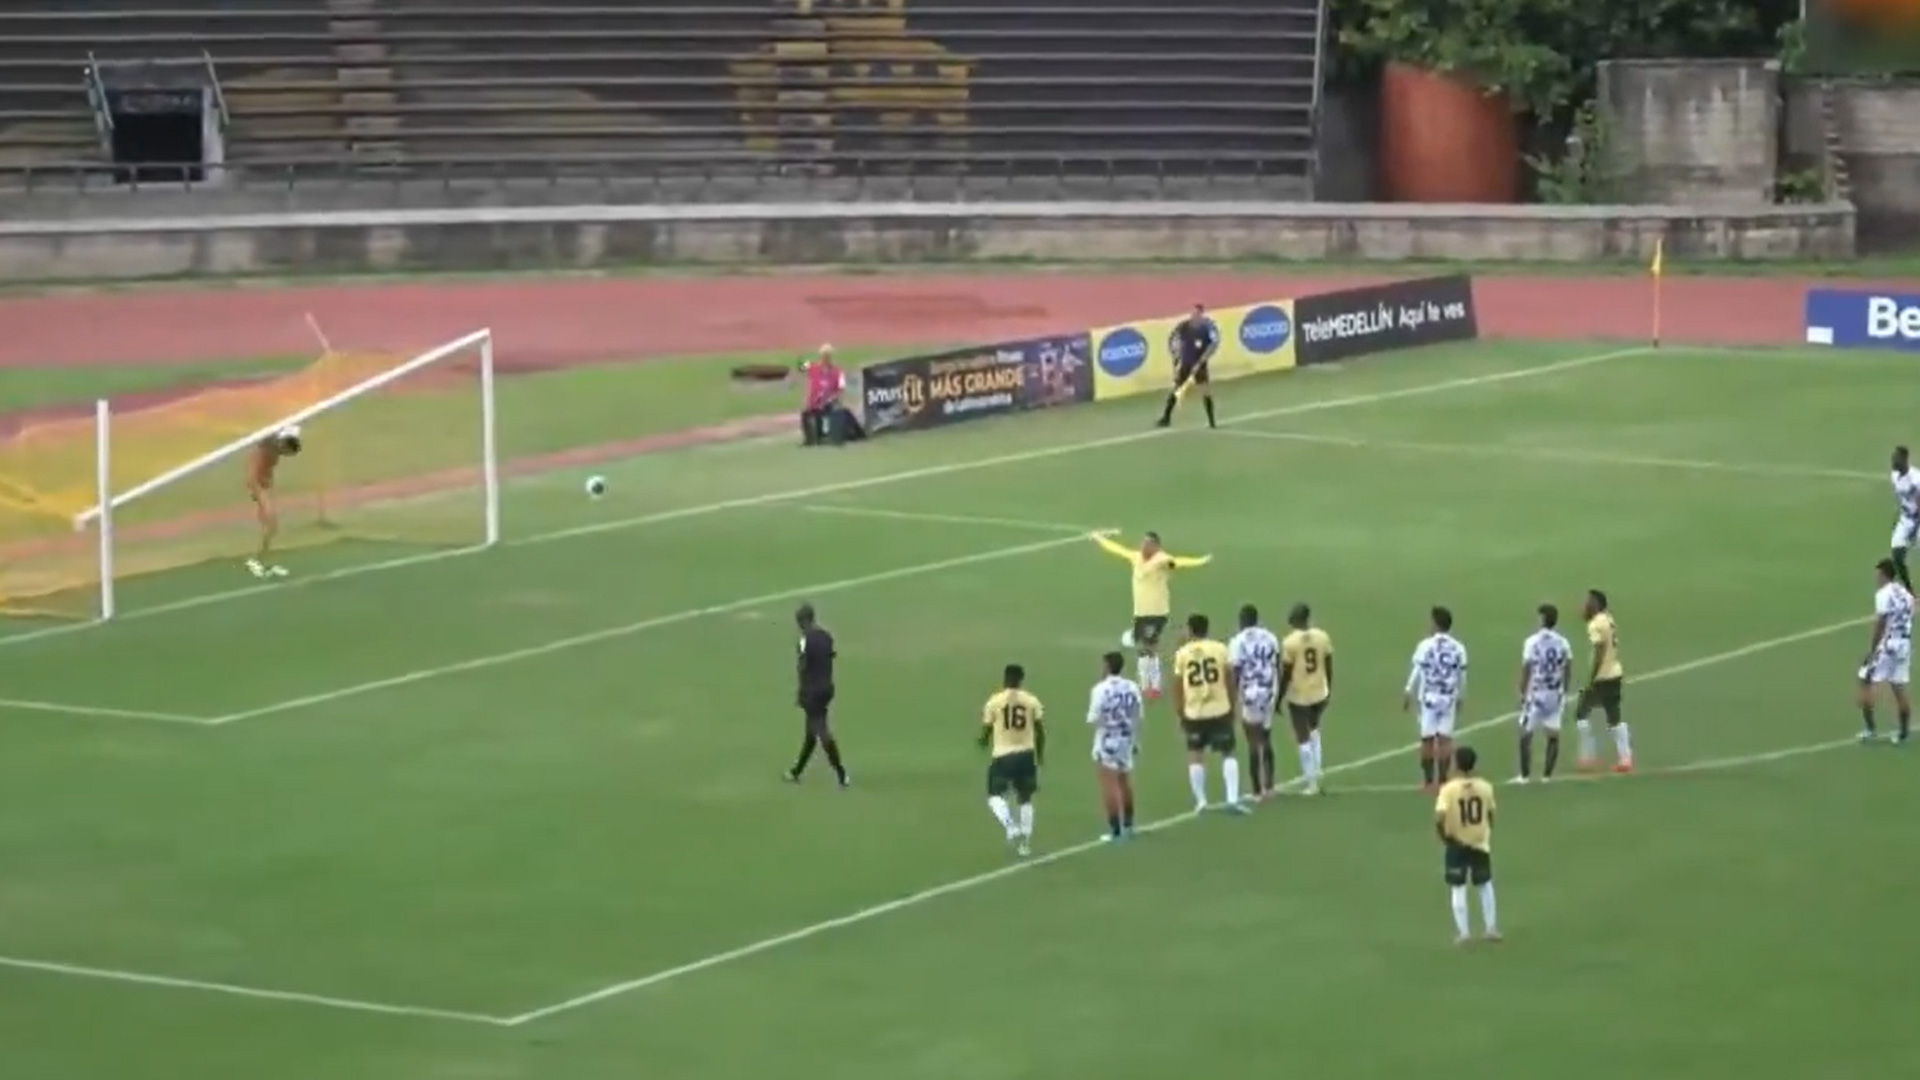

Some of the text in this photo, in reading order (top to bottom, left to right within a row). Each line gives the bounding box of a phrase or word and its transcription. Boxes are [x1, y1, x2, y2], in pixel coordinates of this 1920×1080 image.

[1303, 302, 1393, 342] TeleMEDELLÍN
[1400, 301, 1425, 330] Aquí
[1427, 302, 1440, 321] te
[1444, 302, 1465, 319] ves
[1867, 297, 1920, 338] Be
[965, 366, 1025, 394] GRANDE
[1187, 657, 1219, 686] 26
[1304, 647, 1317, 674] 9
[1003, 703, 1027, 731] 16
[1458, 796, 1482, 827] 10
